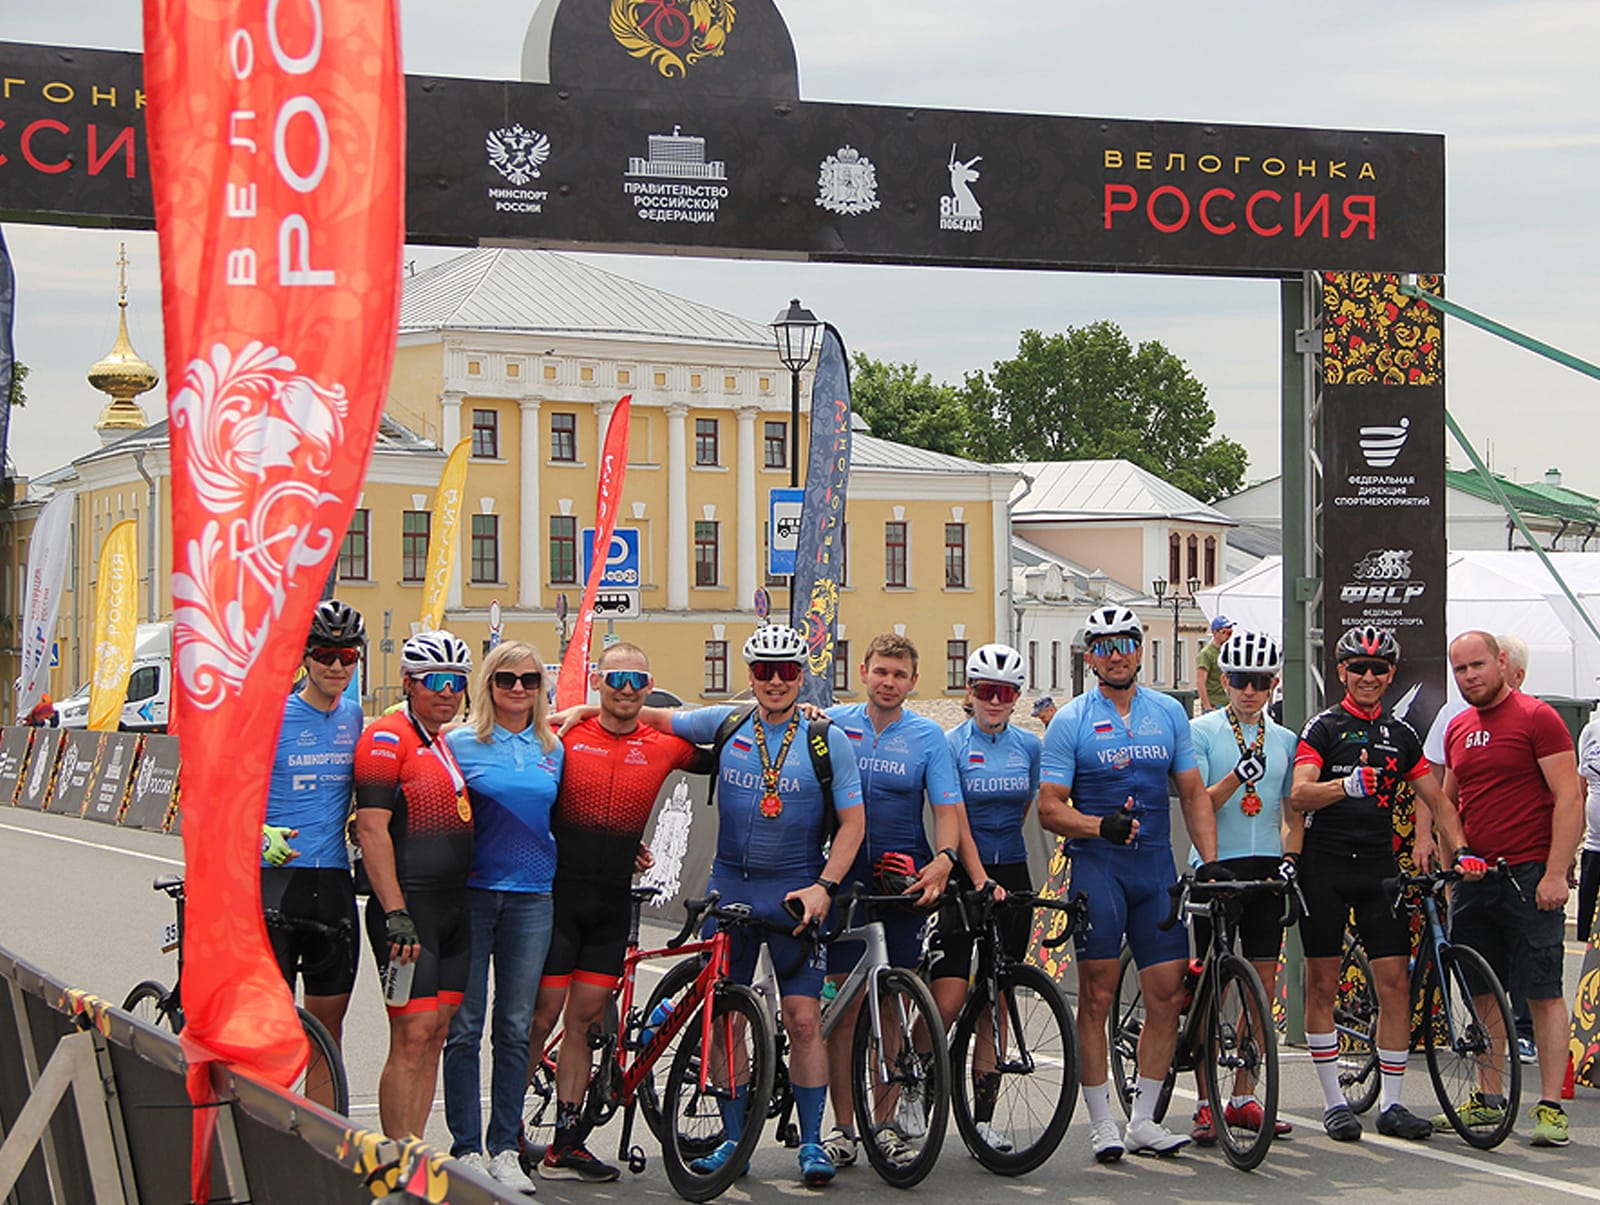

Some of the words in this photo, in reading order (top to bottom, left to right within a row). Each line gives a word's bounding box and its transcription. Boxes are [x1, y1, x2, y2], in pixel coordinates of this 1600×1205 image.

[1103, 149, 1377, 181] ВЕЛОГОНКА
[488, 187, 549, 201] МИНСПОРТ
[623, 182, 729, 199] ПРАВИТЕЛЬСТВО
[495, 201, 542, 214] РОССИИ
[633, 195, 720, 210] РОССИЙСКОЙ
[940, 194, 961, 217] 80
[637, 208, 716, 224] ФЕДЕРАЦИИ
[1103, 183, 1377, 241] РОССИЯ
[1347, 475, 1416, 486] ФЕДЕРАЛЬНАЯ
[1357, 486, 1407, 497] ДИРЕКЦИЯ
[1334, 495, 1431, 507] СПОРТМЕРОПРИЯТИЙ
[107, 552, 126, 635] РОССИЯ
[1464, 730, 1491, 750] GAP
[722, 766, 801, 793] VELOTERA
